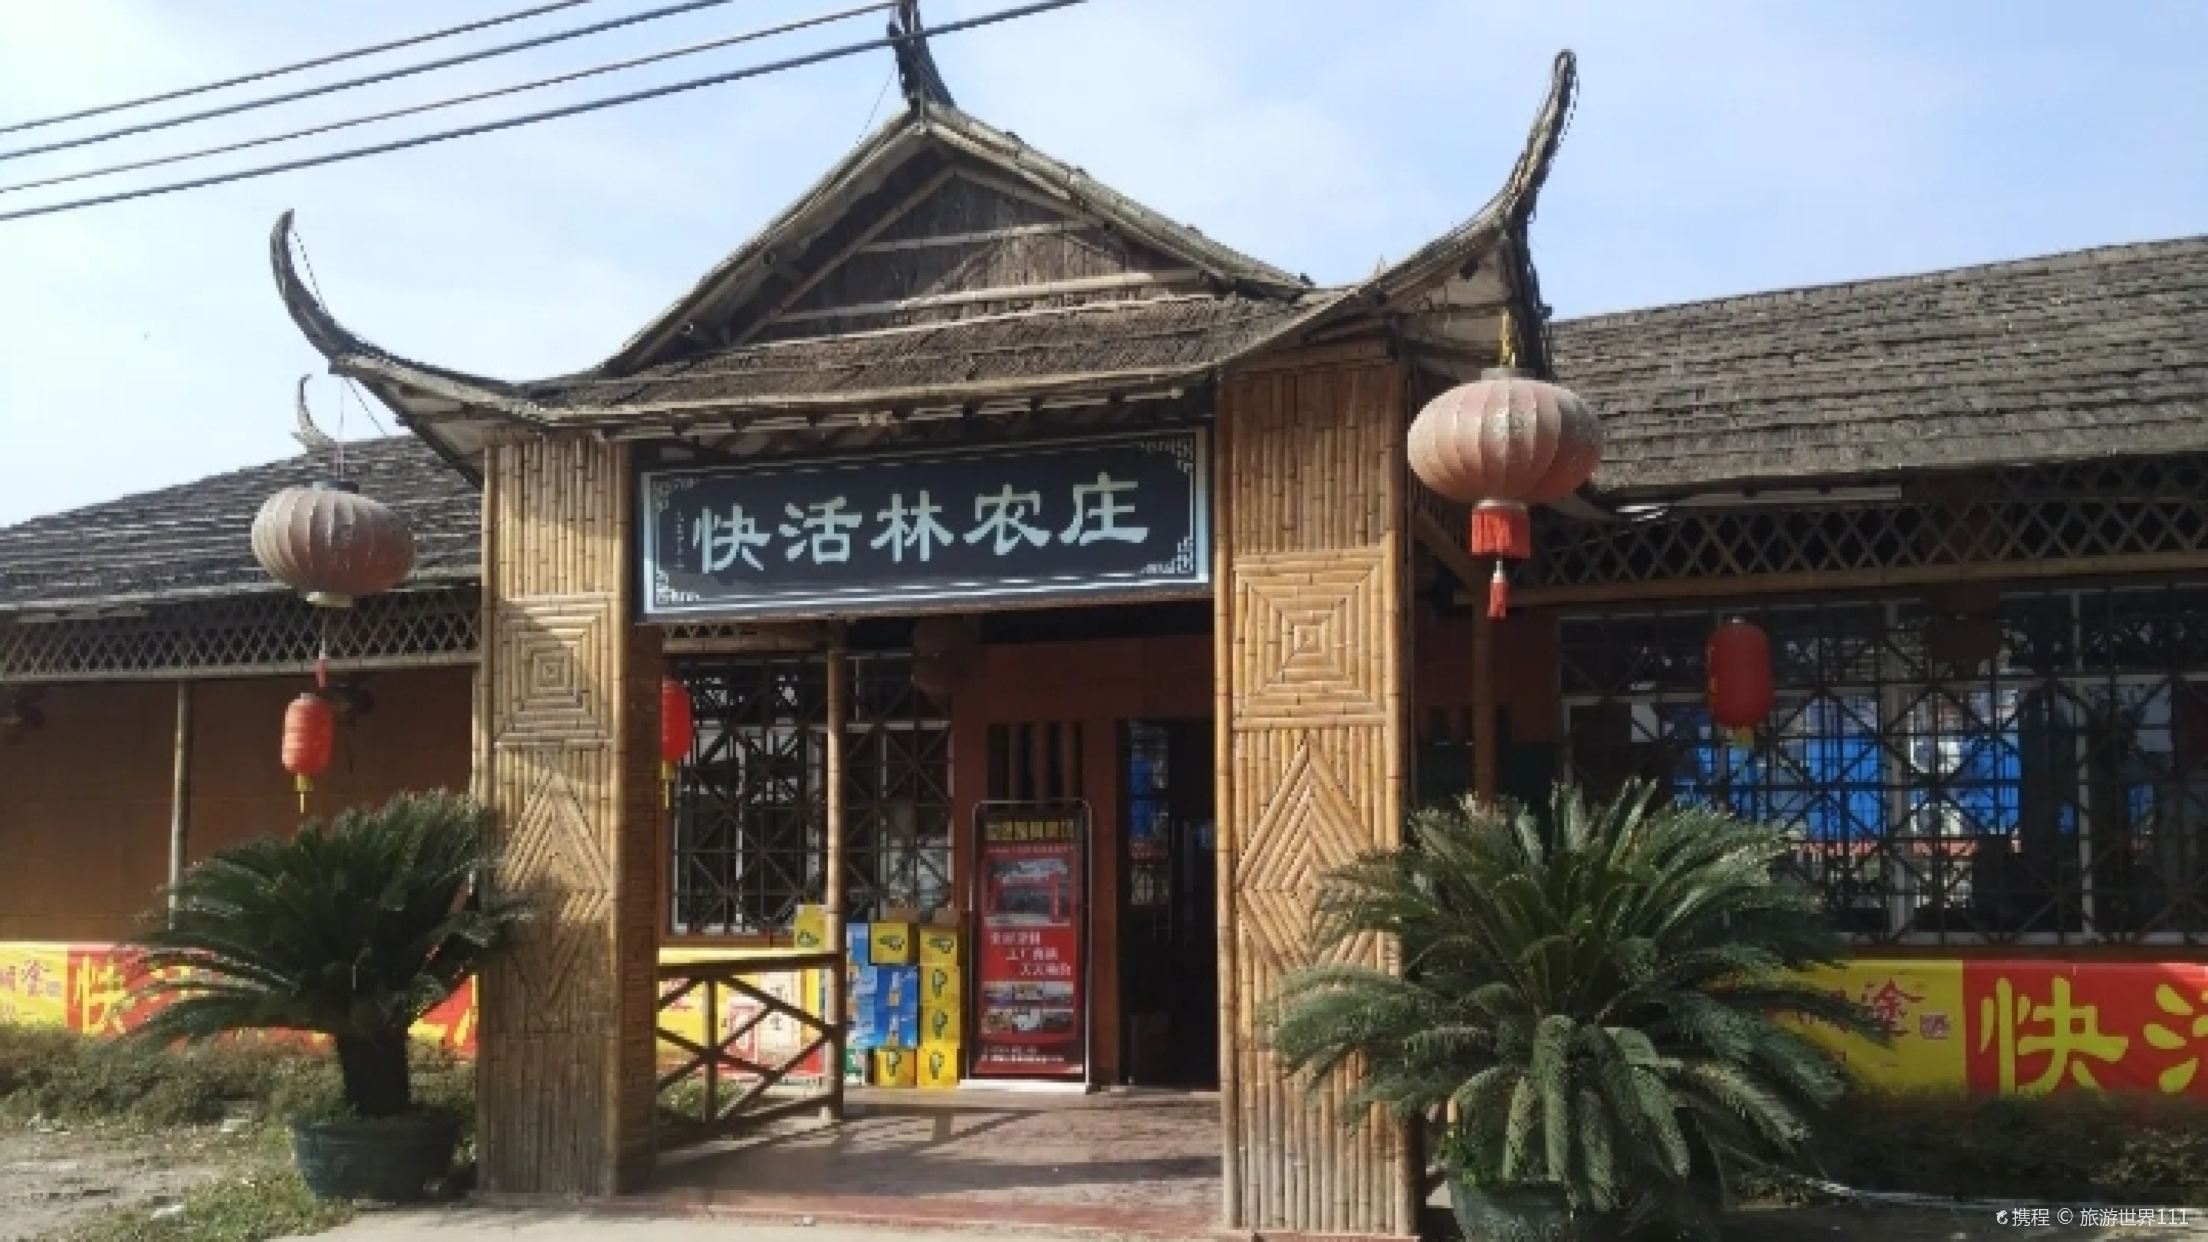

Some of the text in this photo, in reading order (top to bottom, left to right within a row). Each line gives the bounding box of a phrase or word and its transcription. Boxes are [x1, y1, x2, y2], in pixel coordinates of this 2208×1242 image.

[693, 471, 1150, 574] 快活林农庄
